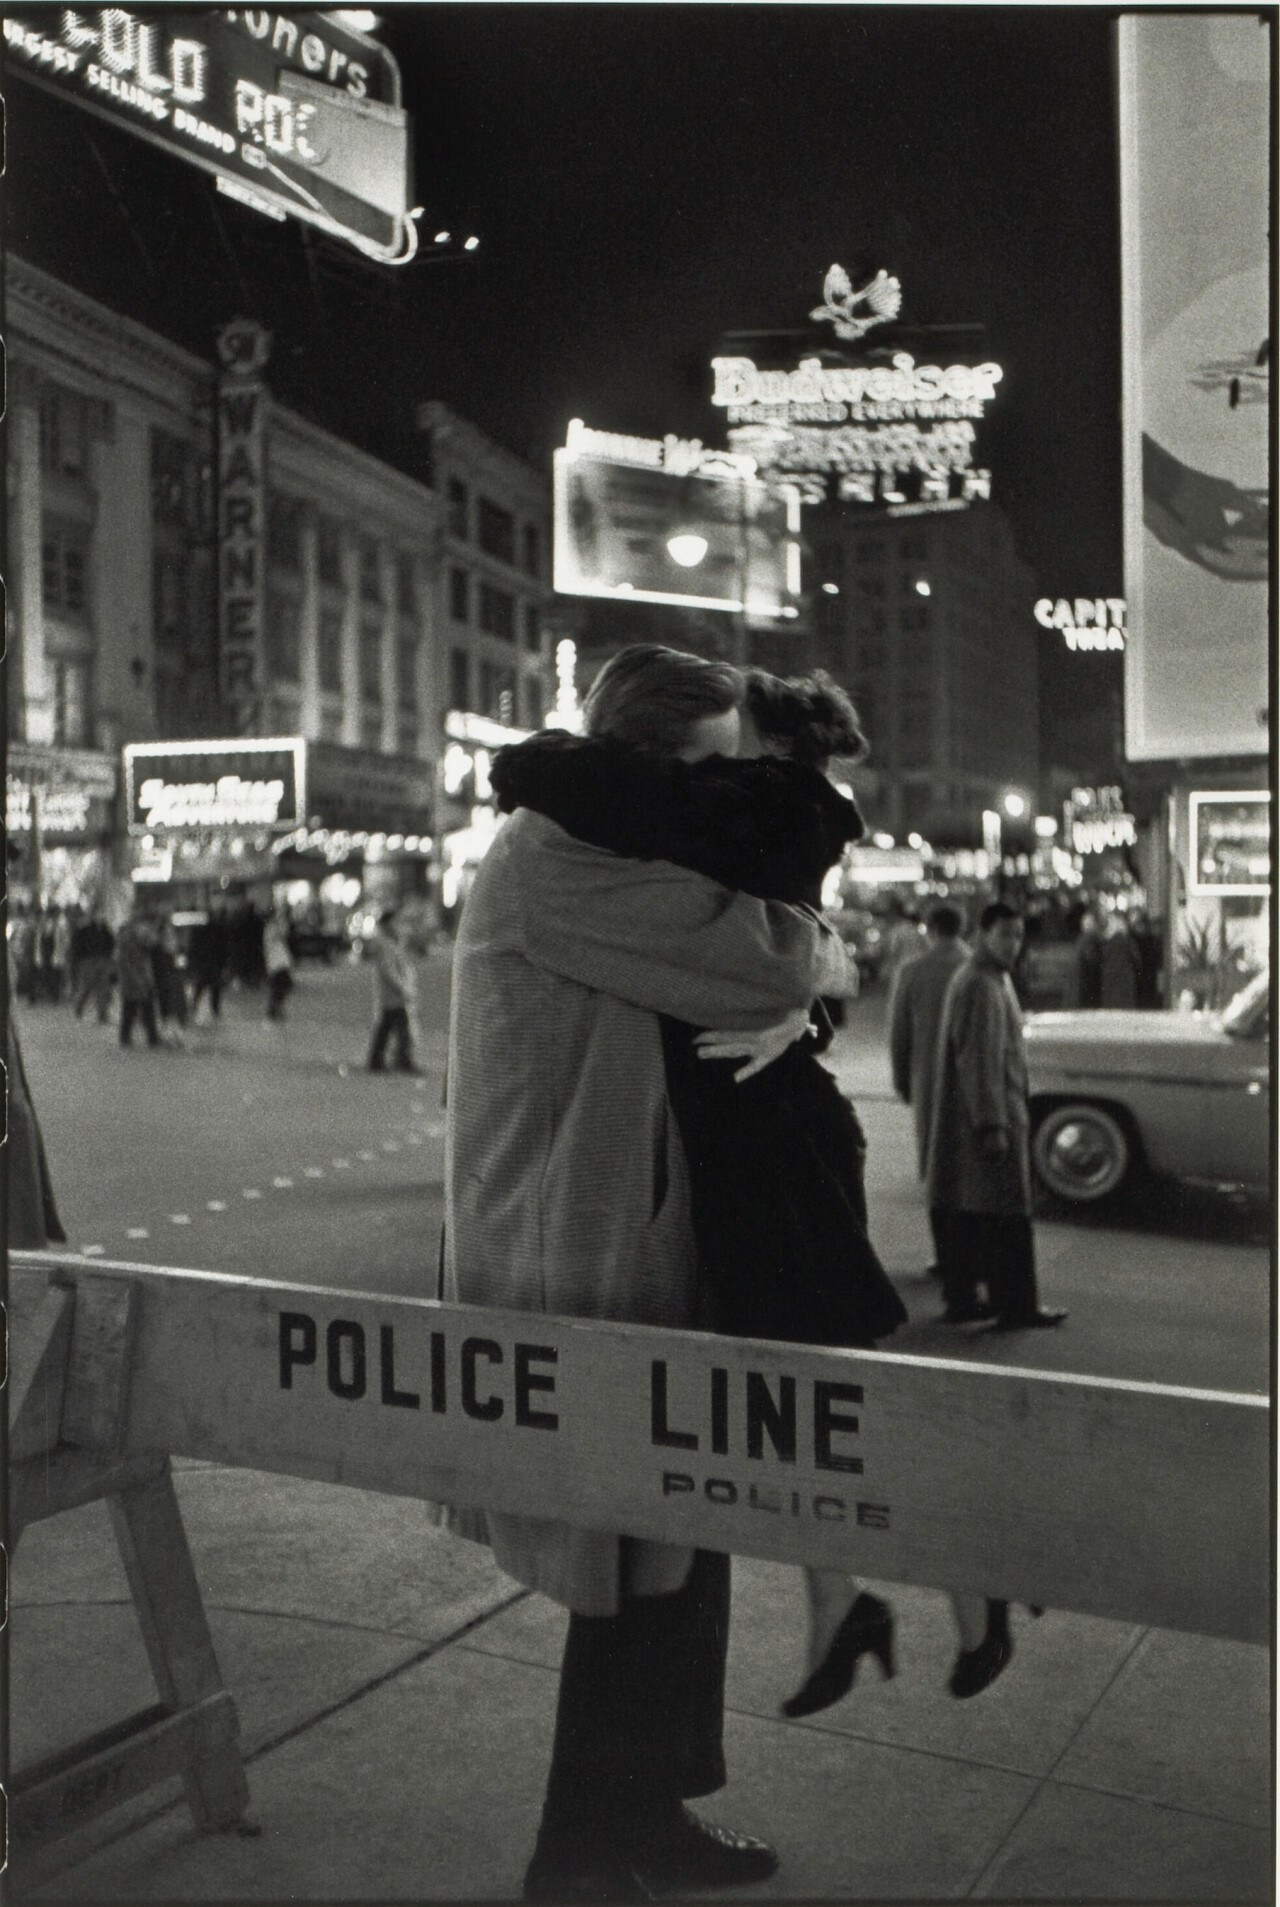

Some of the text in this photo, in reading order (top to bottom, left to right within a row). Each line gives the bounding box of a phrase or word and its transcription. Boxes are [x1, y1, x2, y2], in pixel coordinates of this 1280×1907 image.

[87, 63, 169, 119] SELLING
[174, 108, 236, 154] BRAND
[711, 352, 1003, 406] Budweiser
[221, 391, 259, 690] WARNER
[278, 1311, 864, 1474] POLICE LINE
[662, 1471, 890, 1529] POLICE
